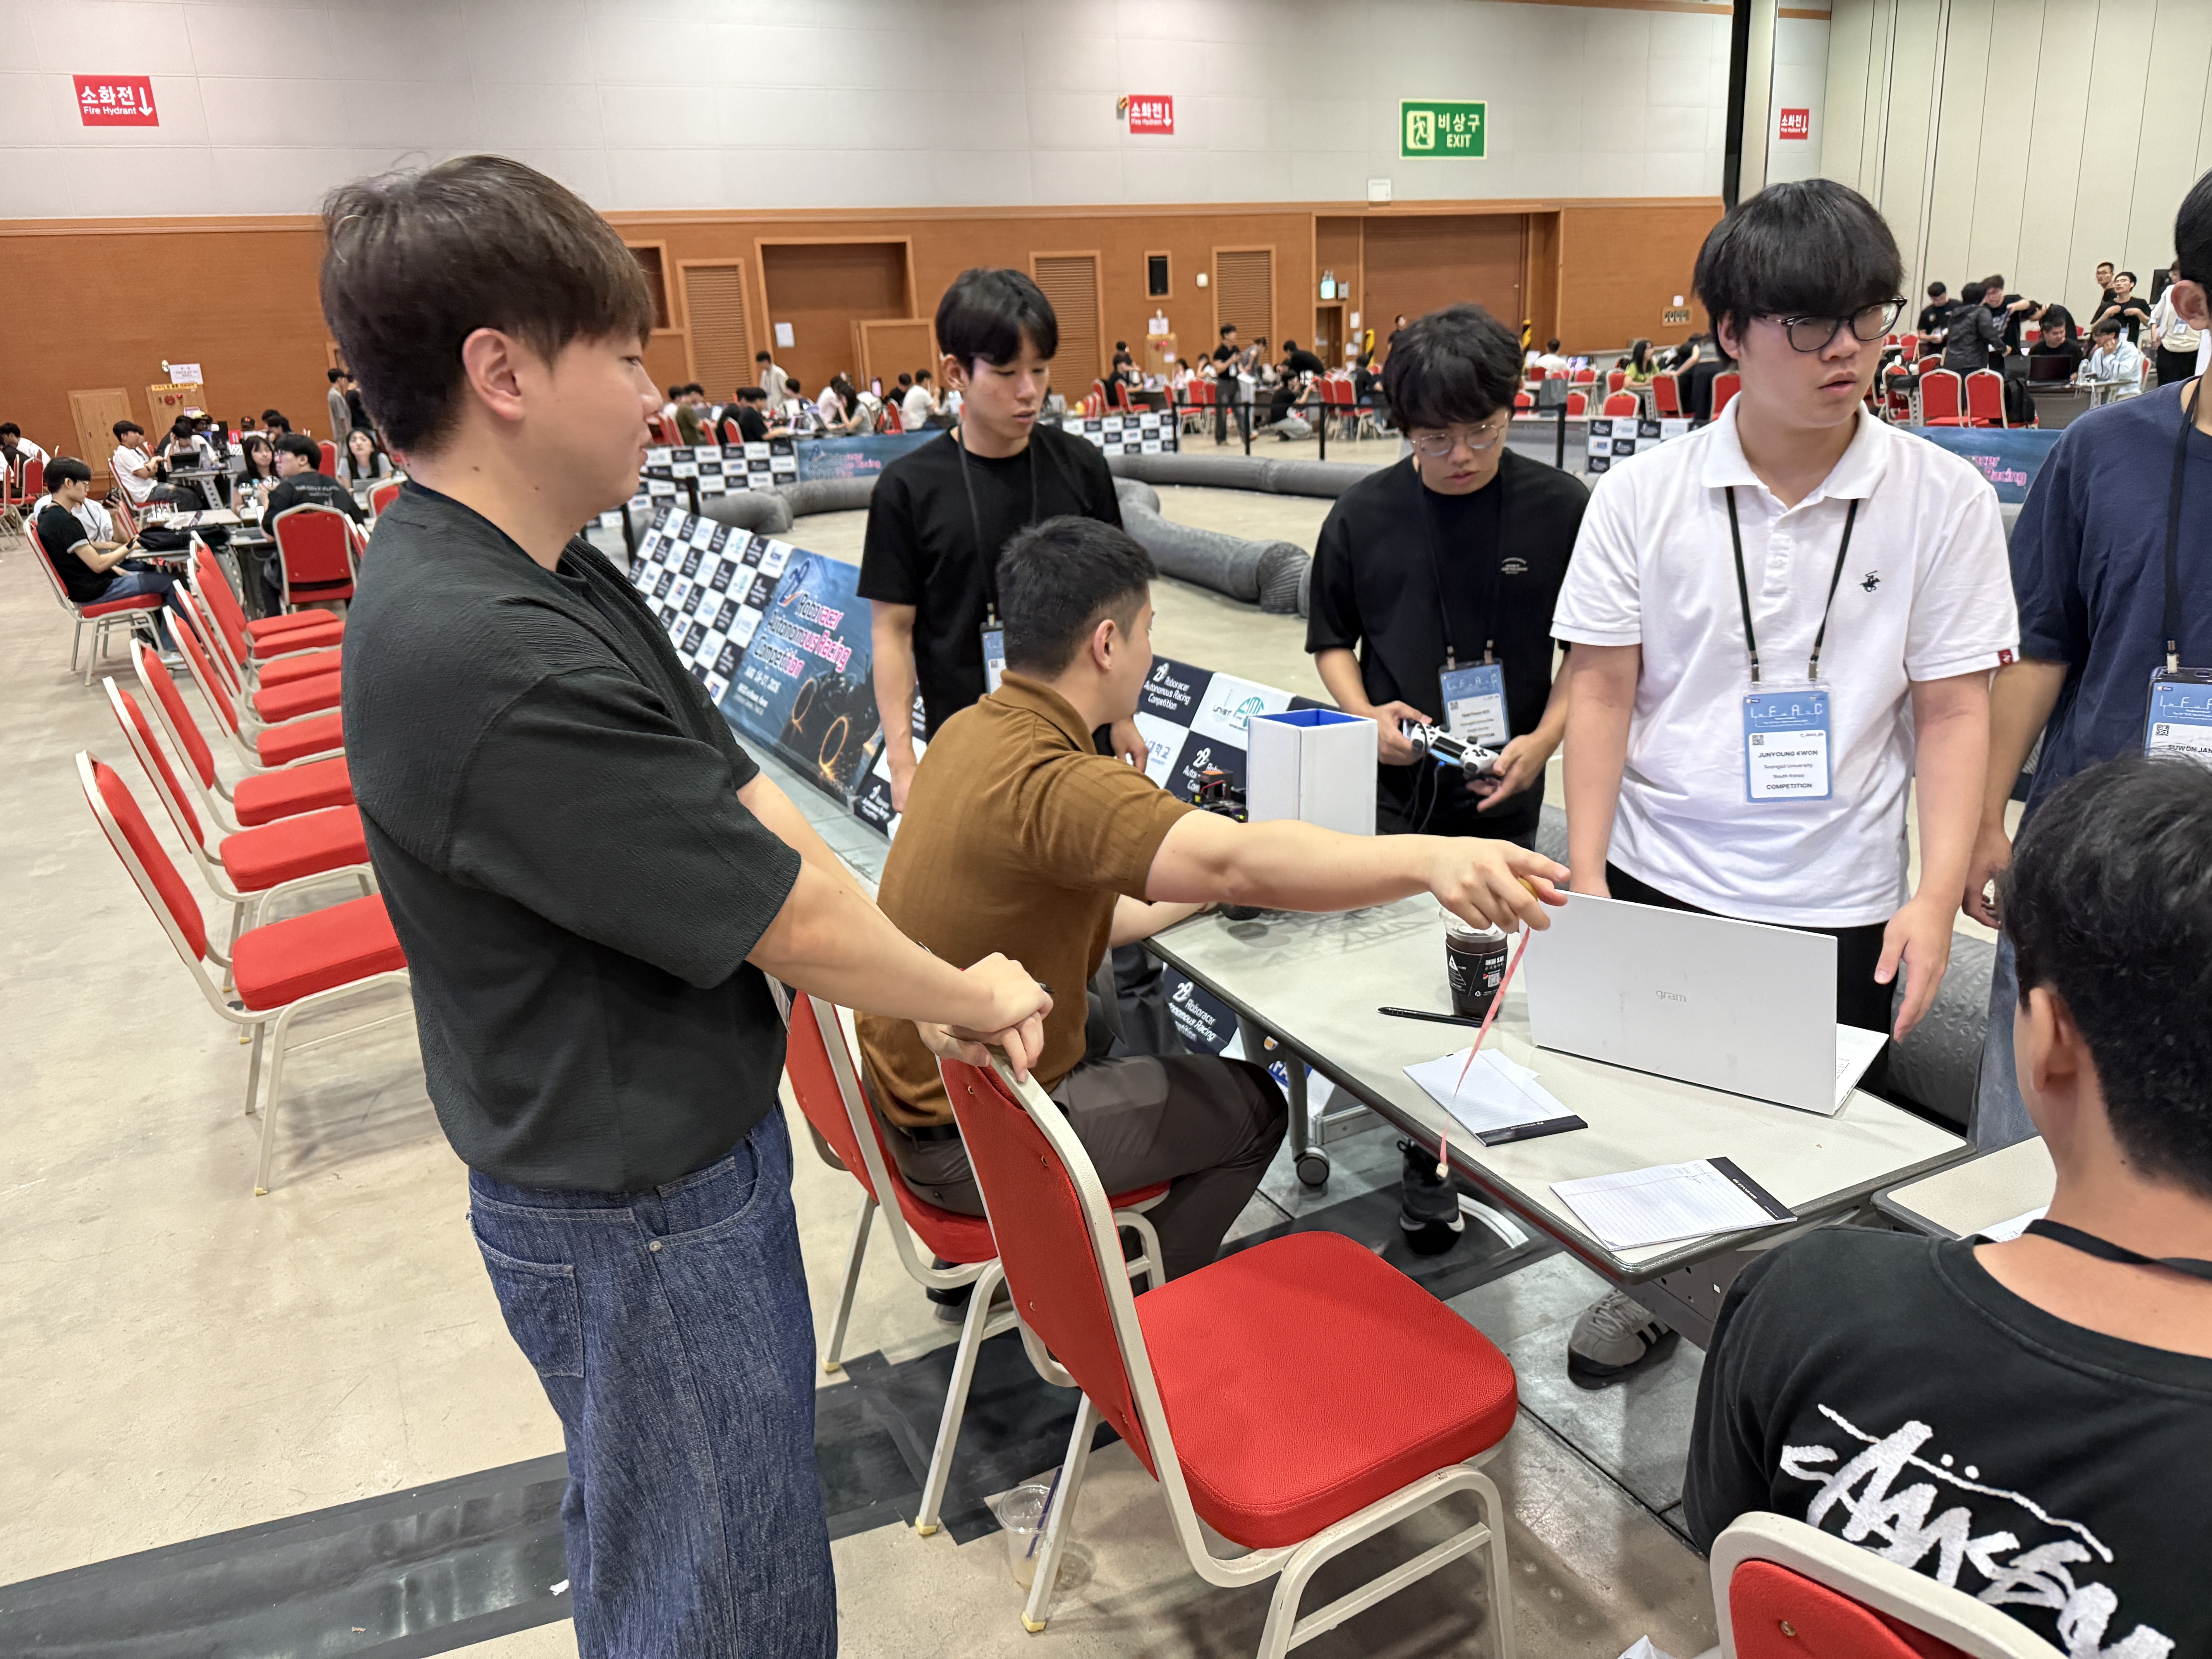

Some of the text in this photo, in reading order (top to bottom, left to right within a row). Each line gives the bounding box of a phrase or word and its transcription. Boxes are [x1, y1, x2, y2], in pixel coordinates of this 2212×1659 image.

[81, 86, 135, 105] 소화전
[83, 106, 137, 115] Fire Hydrant
[1130, 102, 1162, 118] 소화전
[1438, 113, 1480, 133] 비상구
[1446, 134, 1472, 148] EXIT
[814, 629, 852, 673] Racing
[1148, 693, 1178, 711] Competition
[1173, 690, 1192, 706] Racing
[1656, 991, 1686, 1002] gram
[1185, 998, 1217, 1026] Roboracer
[1194, 1019, 1217, 1042] Racing
